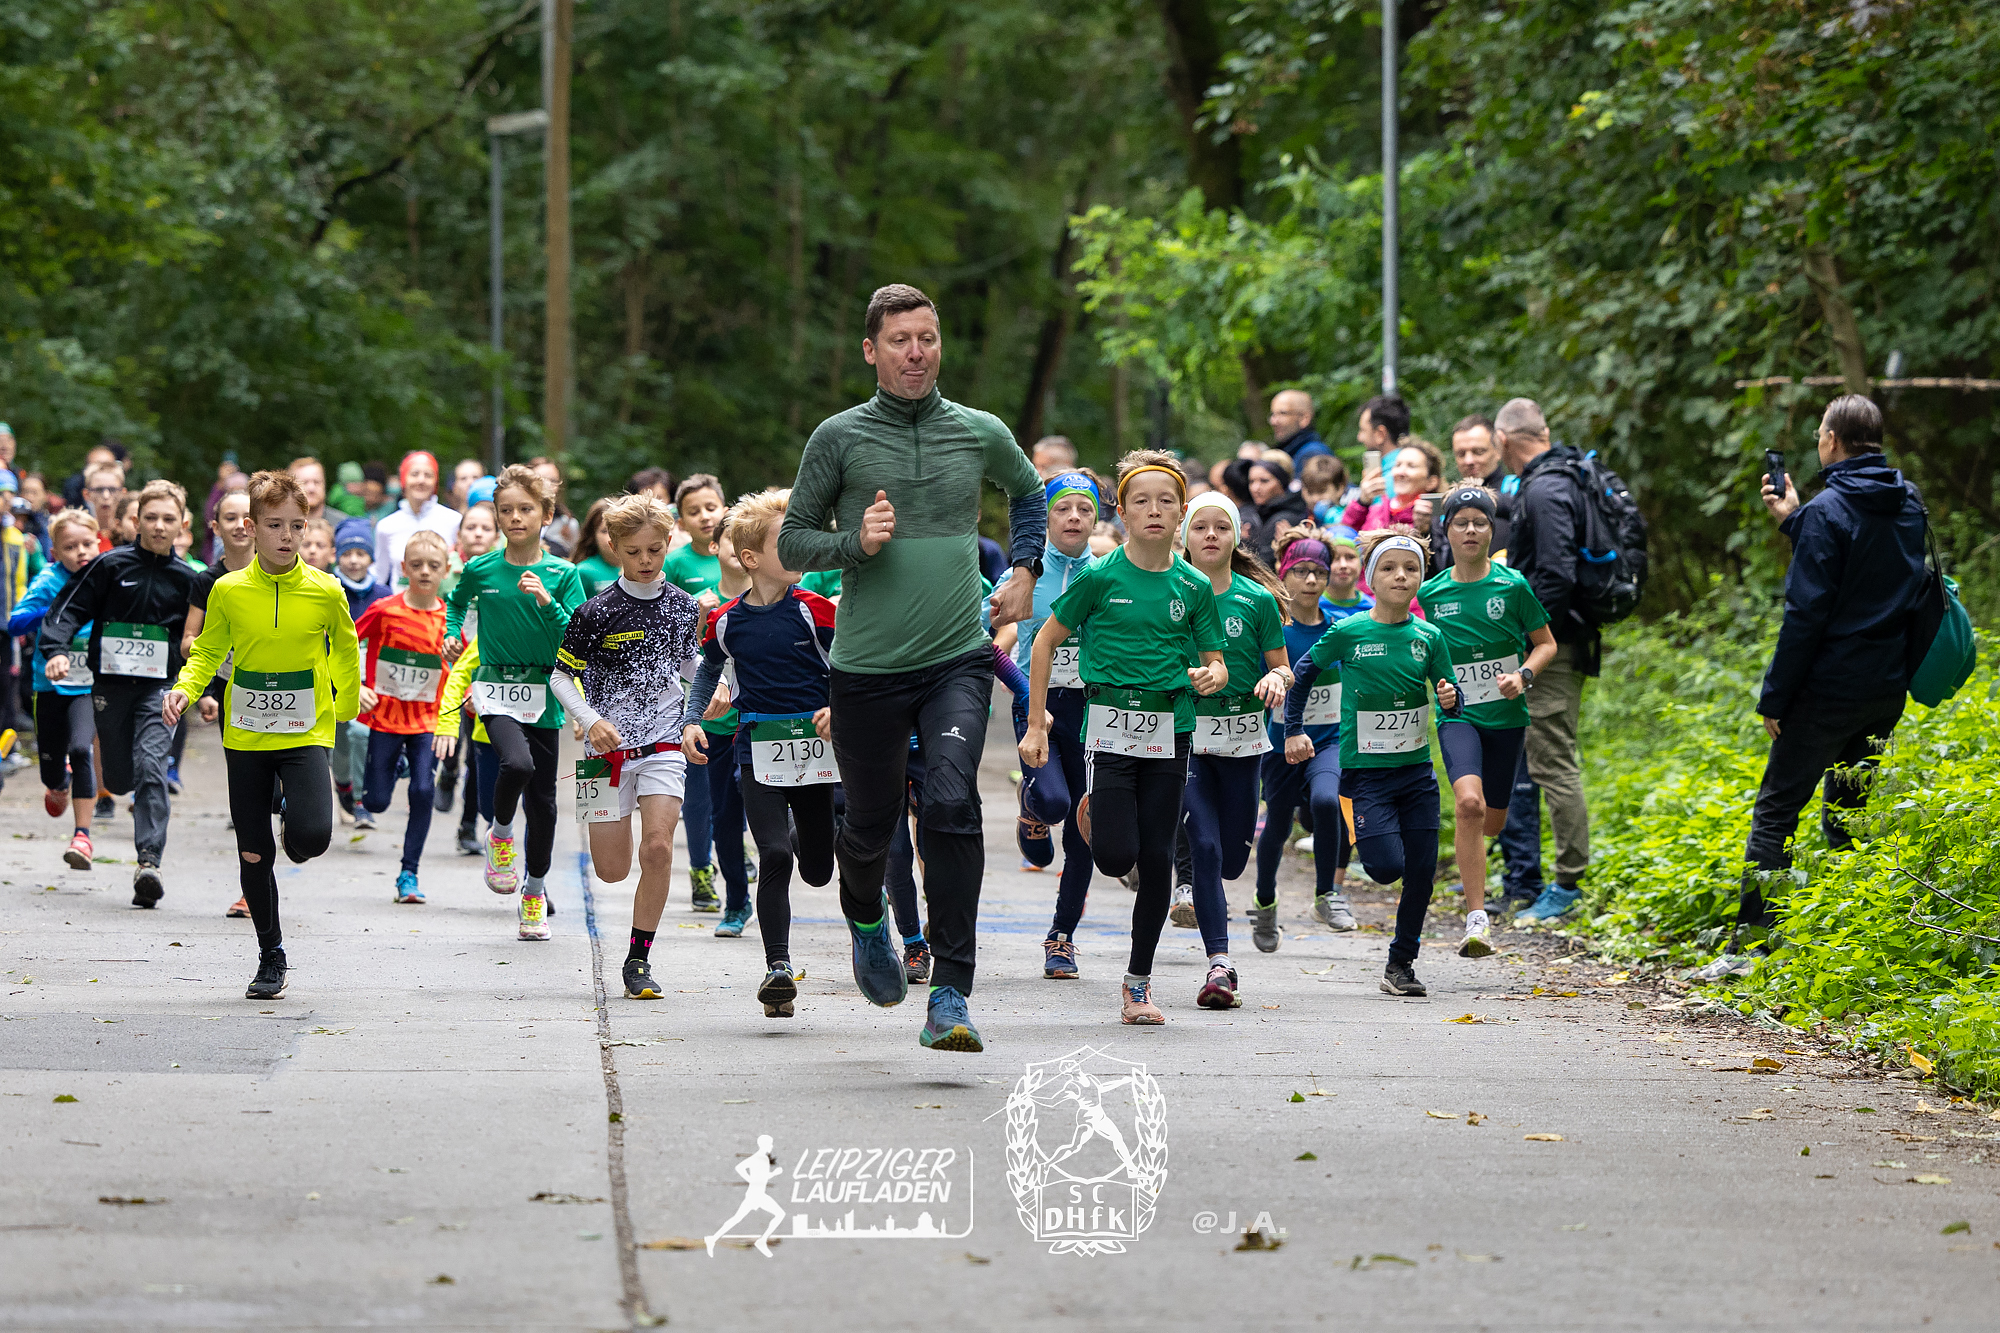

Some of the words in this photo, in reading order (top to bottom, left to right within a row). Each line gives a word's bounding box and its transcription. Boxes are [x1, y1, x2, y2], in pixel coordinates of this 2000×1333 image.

[114, 640, 155, 658] 2228
[68, 653, 87, 669] 20
[388, 664, 430, 685] 2119
[1456, 661, 1504, 683] 2188
[245, 691, 297, 711] 2382
[485, 684, 532, 702] 2160
[1309, 688, 1331, 706] 99
[288, 720, 305, 728] HSB
[1105, 708, 1159, 734] 2129
[1210, 714, 1260, 736] 2153
[1374, 710, 1420, 731] 2274
[1121, 731, 1142, 741] Richard
[771, 738, 824, 763] 2130
[1146, 745, 1163, 753] HSB
[817, 770, 833, 778] HSB
[594, 809, 609, 817] HSB
